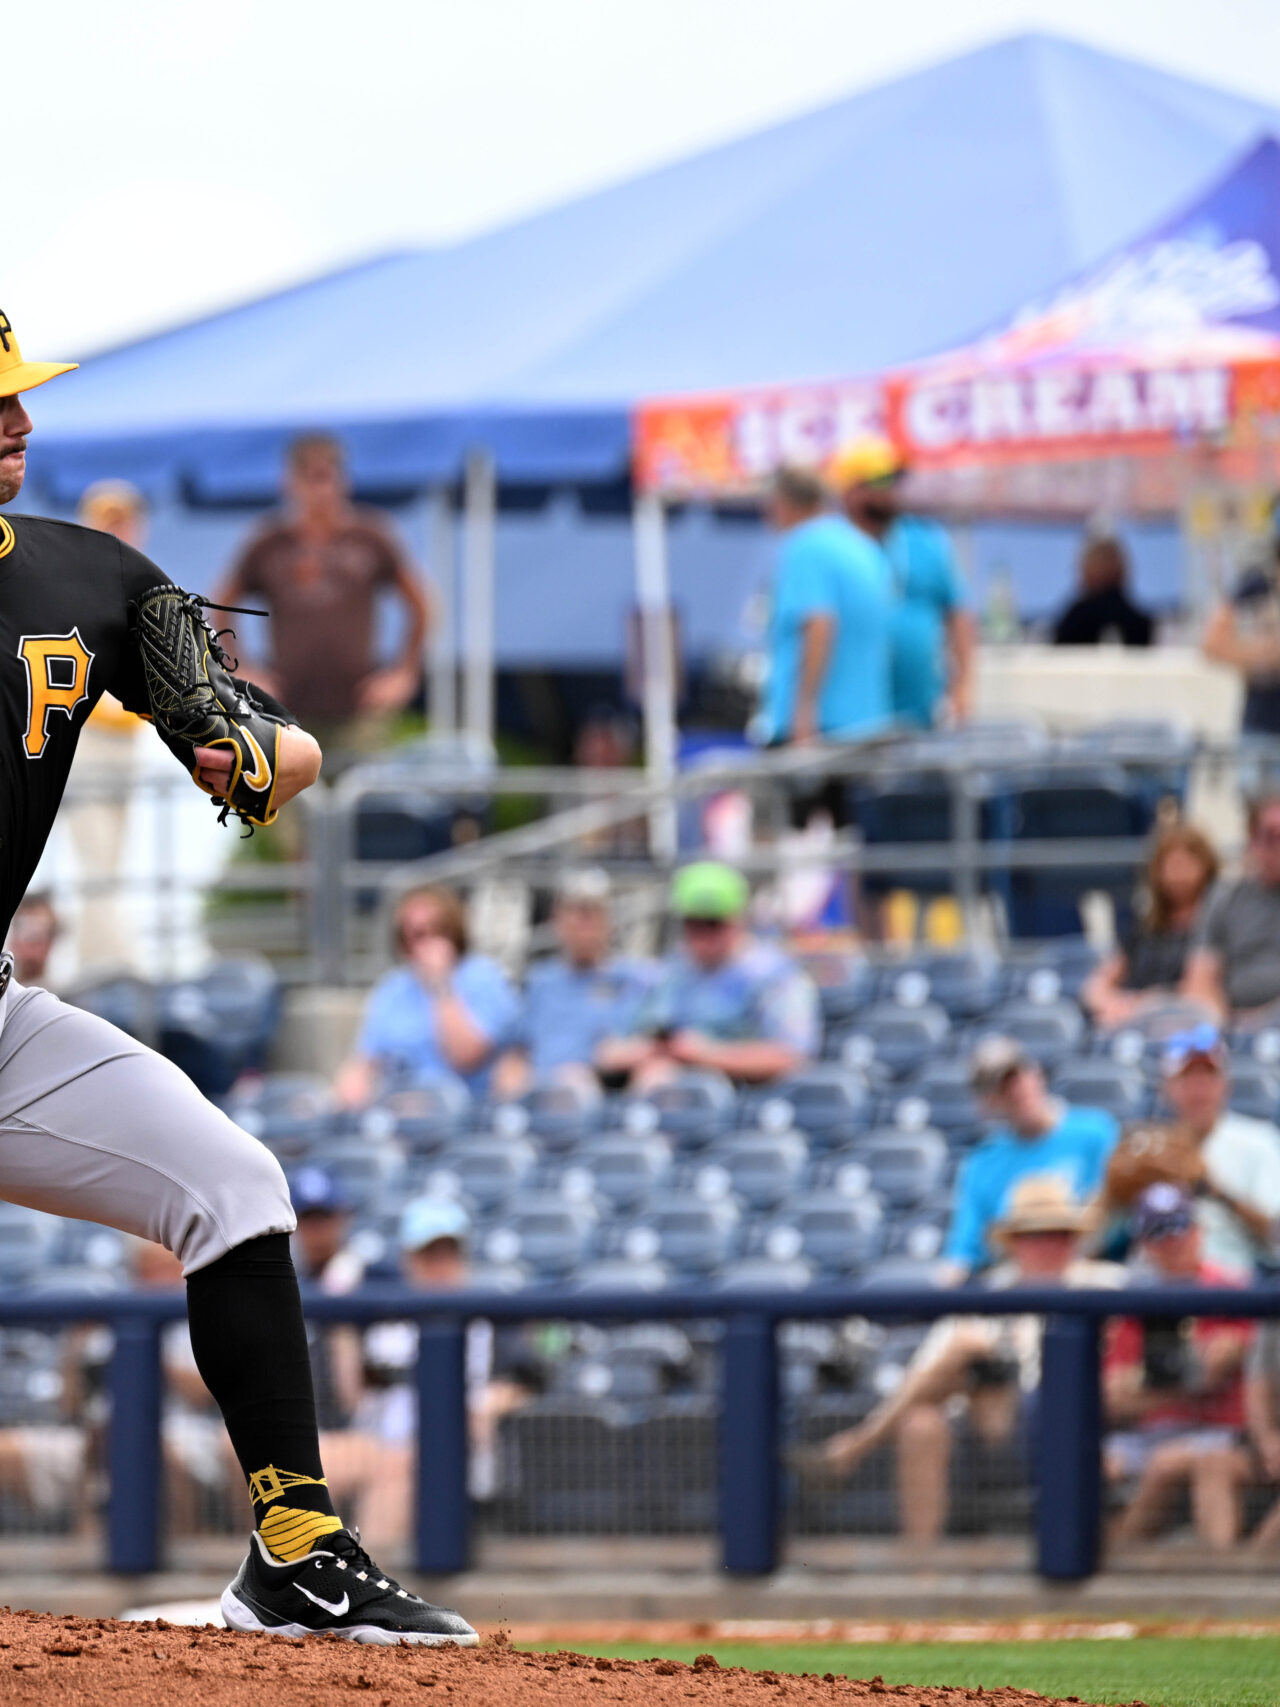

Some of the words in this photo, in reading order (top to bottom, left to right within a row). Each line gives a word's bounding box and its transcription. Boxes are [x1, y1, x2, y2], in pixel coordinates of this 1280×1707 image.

[734, 388, 885, 475] ICE
[904, 366, 1231, 450] CREAM
[17, 626, 96, 759] P
